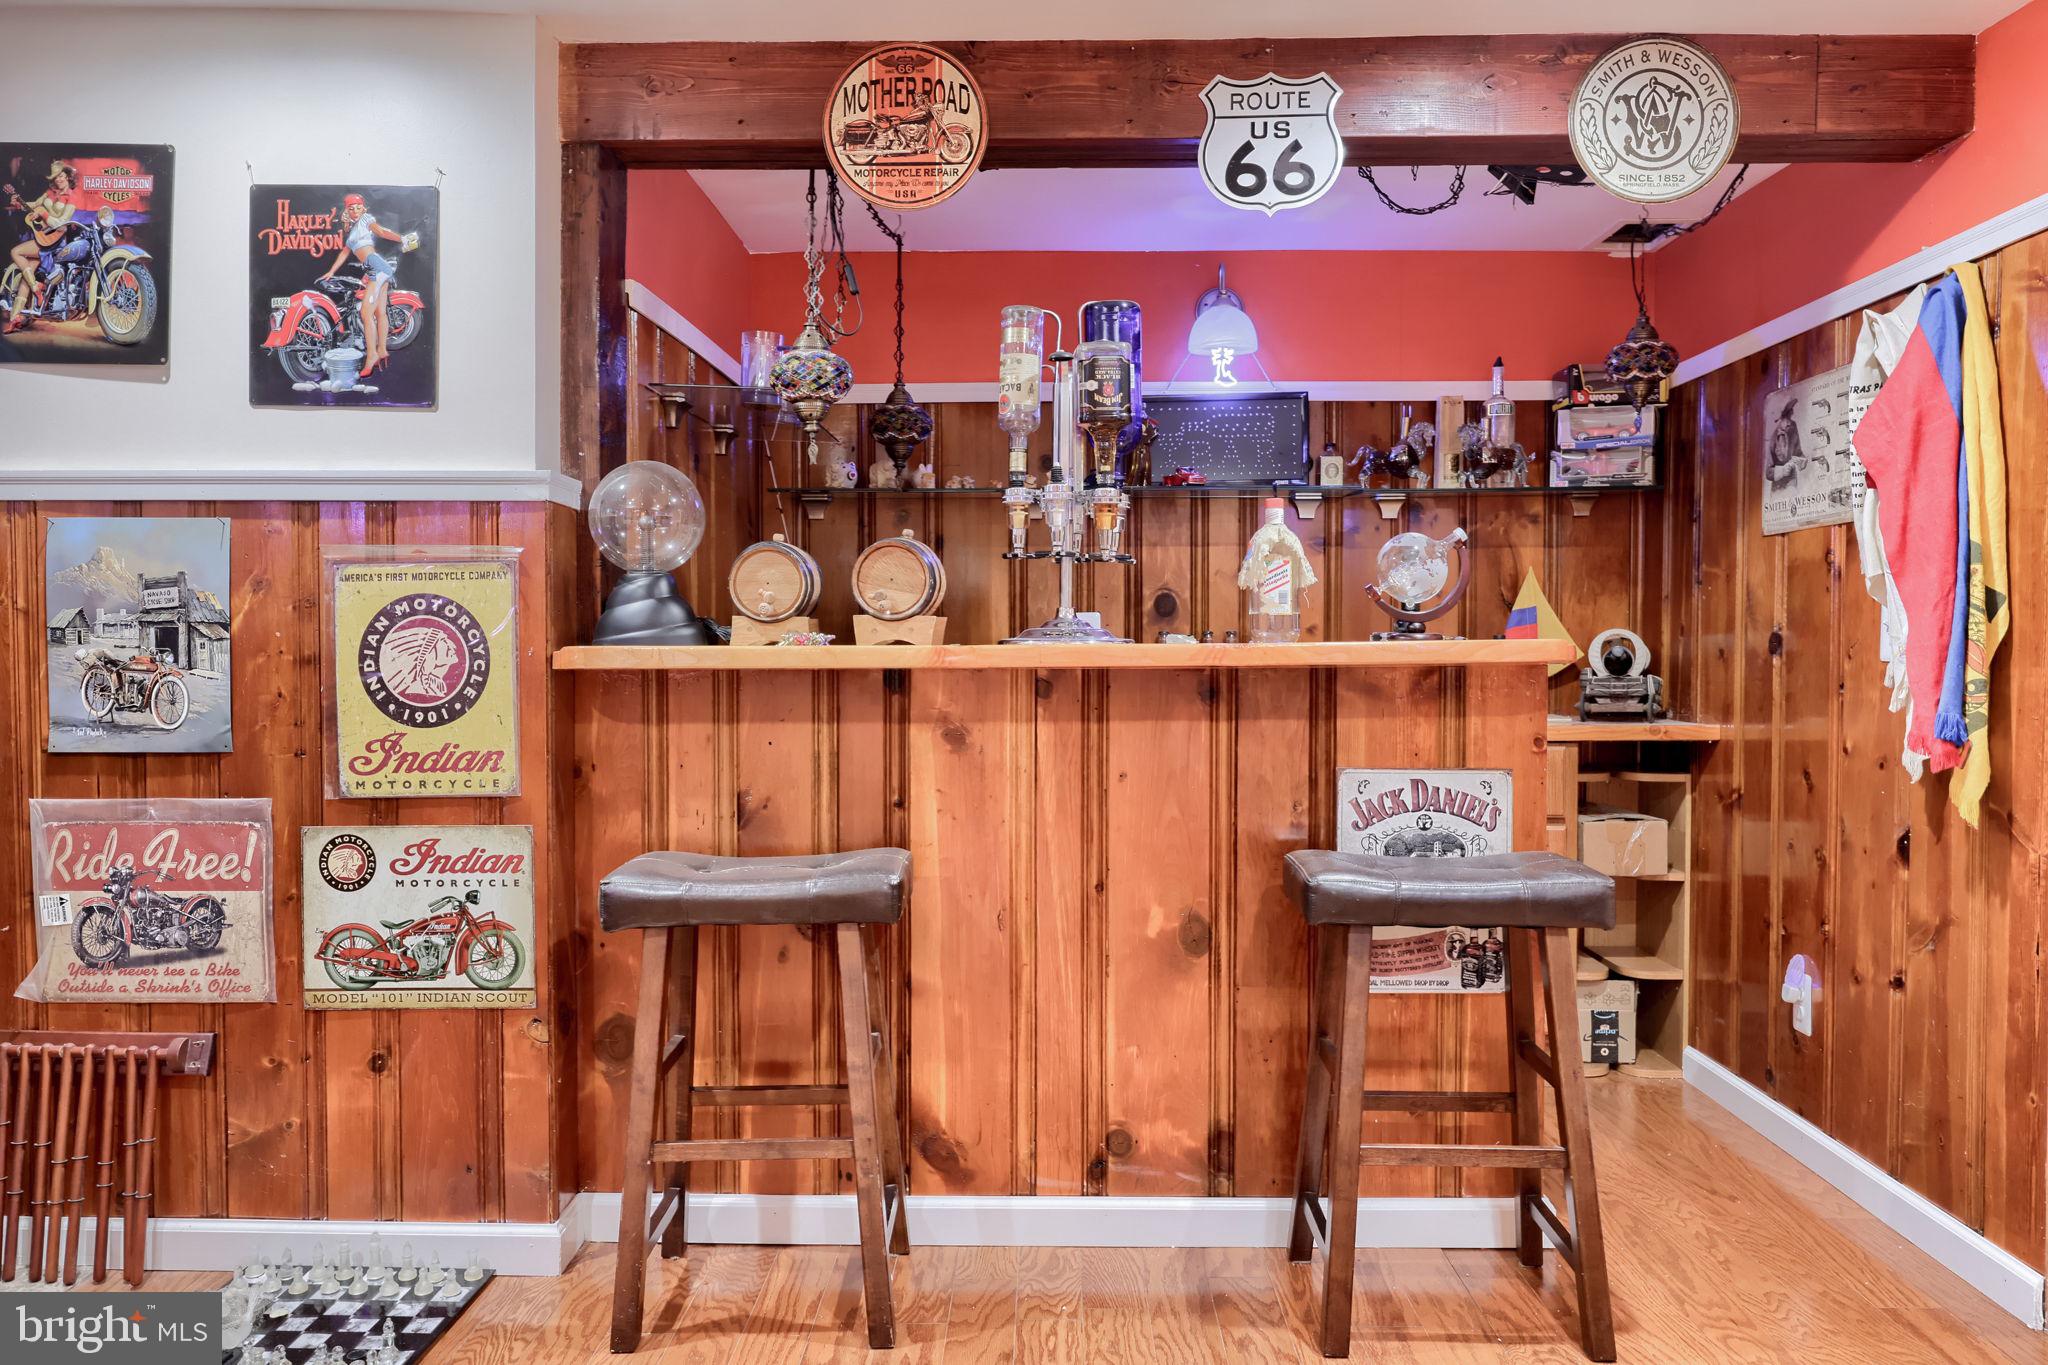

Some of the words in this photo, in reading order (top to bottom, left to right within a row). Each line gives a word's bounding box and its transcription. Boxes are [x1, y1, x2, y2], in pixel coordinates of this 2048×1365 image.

[1591, 53, 1636, 98] SMITH
[1640, 49, 1651, 64] &
[1657, 48, 1719, 98] WESSON
[843, 76, 917, 118] MOTHER
[921, 77, 971, 115] ROAD
[1230, 90, 1311, 111] ROUTE
[1250, 120, 1291, 140] US
[103, 166, 132, 176] MOTOR
[854, 168, 921, 178] MOTORCYCLE
[923, 168, 959, 177] REPAIR
[1224, 138, 1316, 198] 66
[1618, 174, 1654, 182] SINCE
[1658, 174, 1686, 183] 1852
[103, 191, 131, 202] CYCLES
[894, 189, 917, 198] USA
[257, 228, 344, 258] DAVIDSON
[1764, 500, 1787, 513] SMITH
[1795, 492, 1826, 506] WESSON
[339, 573, 383, 582] AMERICA'S
[385, 572, 408, 582] FIRST
[411, 571, 465, 581] MOTORCYCLE
[468, 571, 508, 581] COMPANY
[363, 615, 391, 701] INDIAN
[394, 597, 486, 700] MOTORCYCLE
[402, 707, 450, 723] 1901
[348, 731, 506, 777] Indian
[355, 778, 501, 790] MOTORCYCLE
[1348, 787, 1411, 832] JACK
[1408, 778, 1502, 833] DANIEL'S
[44, 826, 136, 883] Ride
[142, 827, 258, 883] Free!
[320, 843, 334, 881] INDIAN
[334, 835, 375, 880] MOTORCYCLE
[389, 838, 525, 876] Indian
[337, 883, 359, 891] 1901
[395, 879, 520, 888] MOTORCYCLE
[67, 961, 115, 979] You'll
[116, 966, 160, 977] never
[163, 967, 186, 977] see
[189, 967, 200, 977] a
[204, 961, 241, 977] Bike
[57, 978, 114, 994] Outside
[118, 983, 129, 993] a
[134, 978, 203, 993] Shrink's
[207, 978, 252, 998] Office
[1436, 979, 1450, 987] DROP
[312, 993, 368, 1004] MODEL
[417, 992, 472, 1003] INDIAN
[475, 992, 528, 1003] SCOUT
